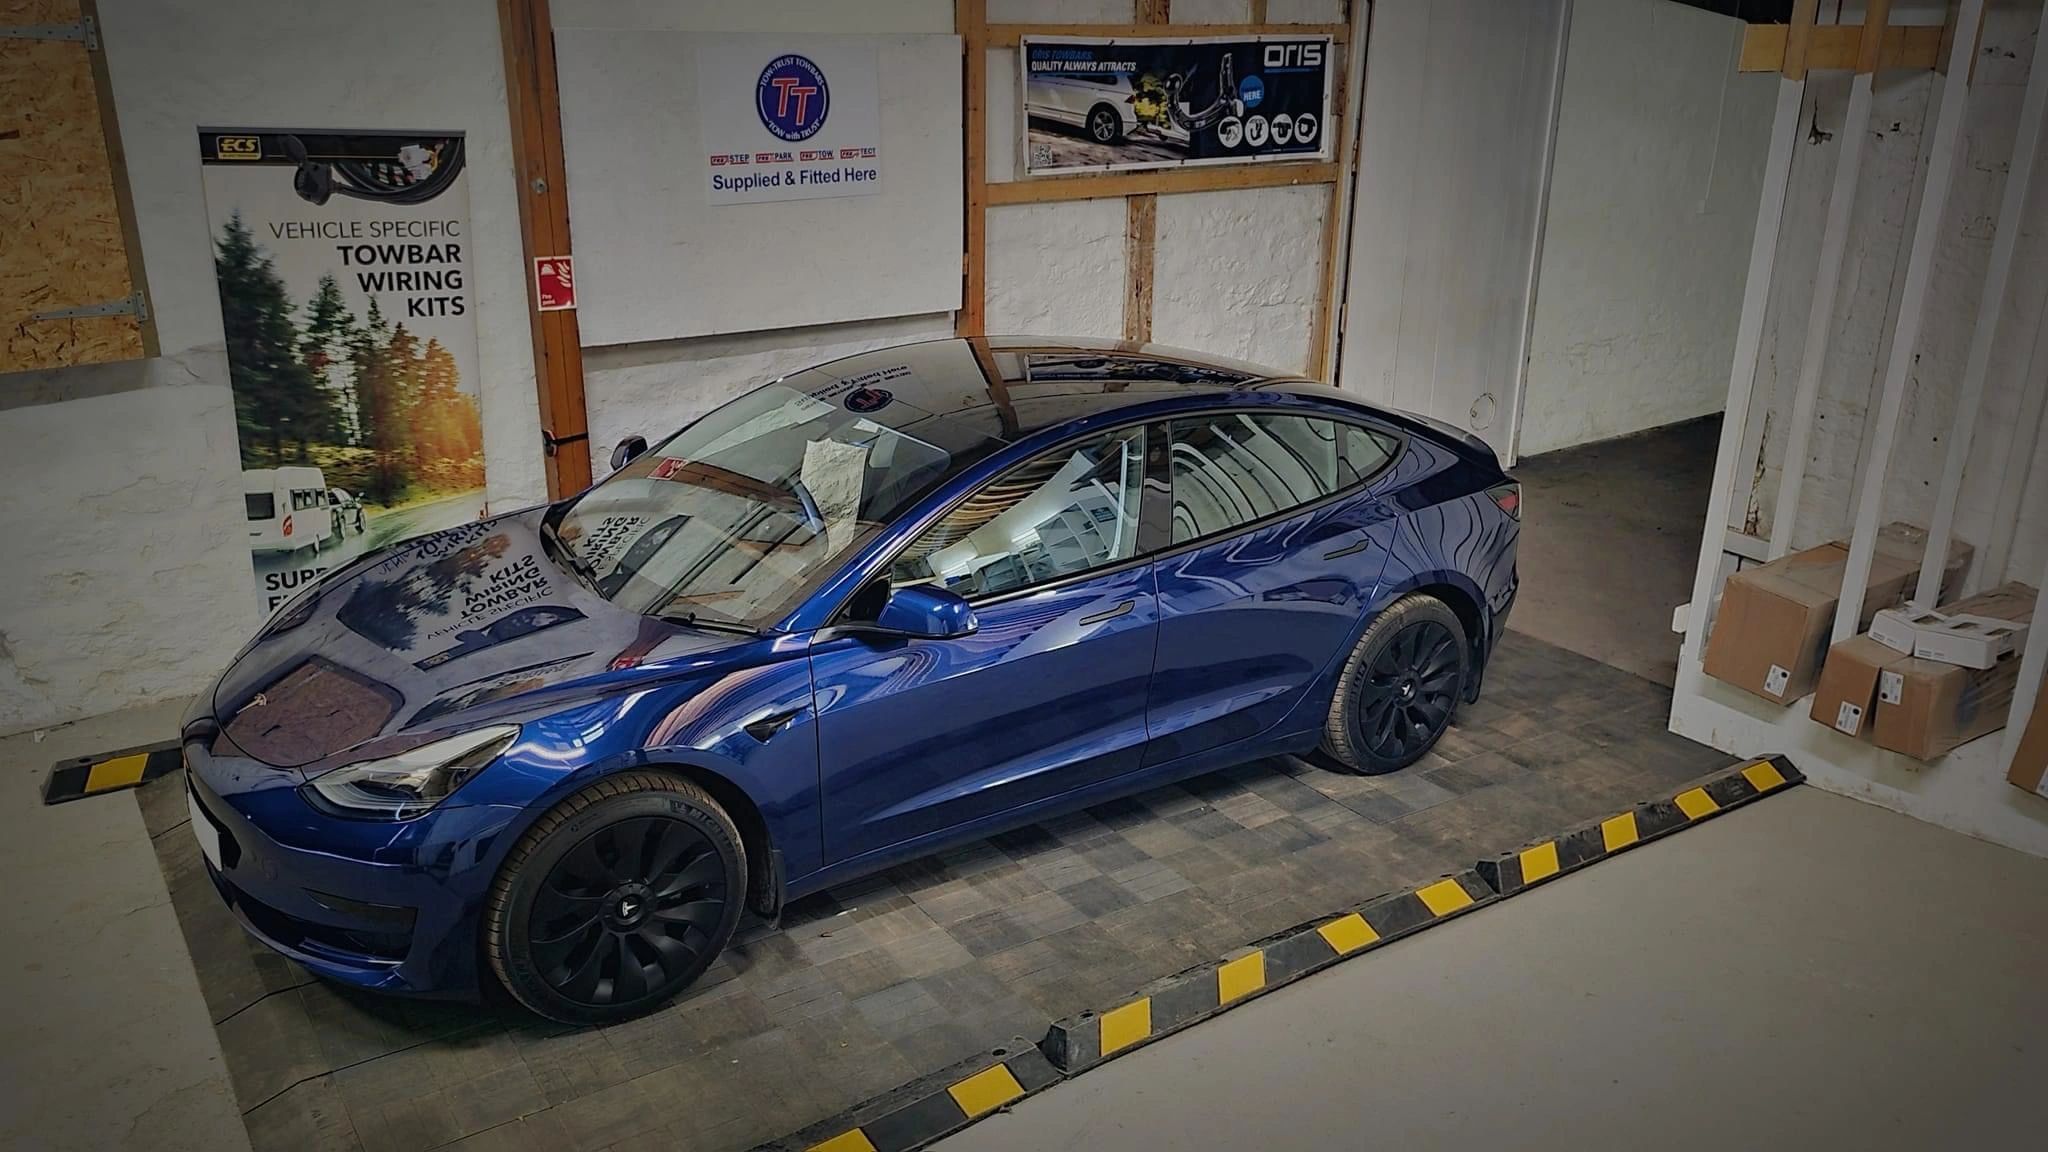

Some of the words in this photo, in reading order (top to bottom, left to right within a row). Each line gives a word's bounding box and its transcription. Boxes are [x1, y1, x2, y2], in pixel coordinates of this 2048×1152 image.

[1031, 61, 1062, 71] QUALITY
[1063, 61, 1097, 71] ALWAYS
[1097, 62, 1137, 71] ATTRACTS
[220, 138, 257, 152] ECS
[713, 172, 780, 192] Supplied
[784, 170, 796, 186] &
[800, 168, 840, 185] Fitted
[844, 167, 877, 182] Here
[269, 222, 363, 240] VEHICLE
[370, 220, 461, 238] SPECIFIC
[337, 244, 462, 266] TOWBAR
[357, 271, 463, 292] WIRING
[408, 296, 465, 317] KITS
